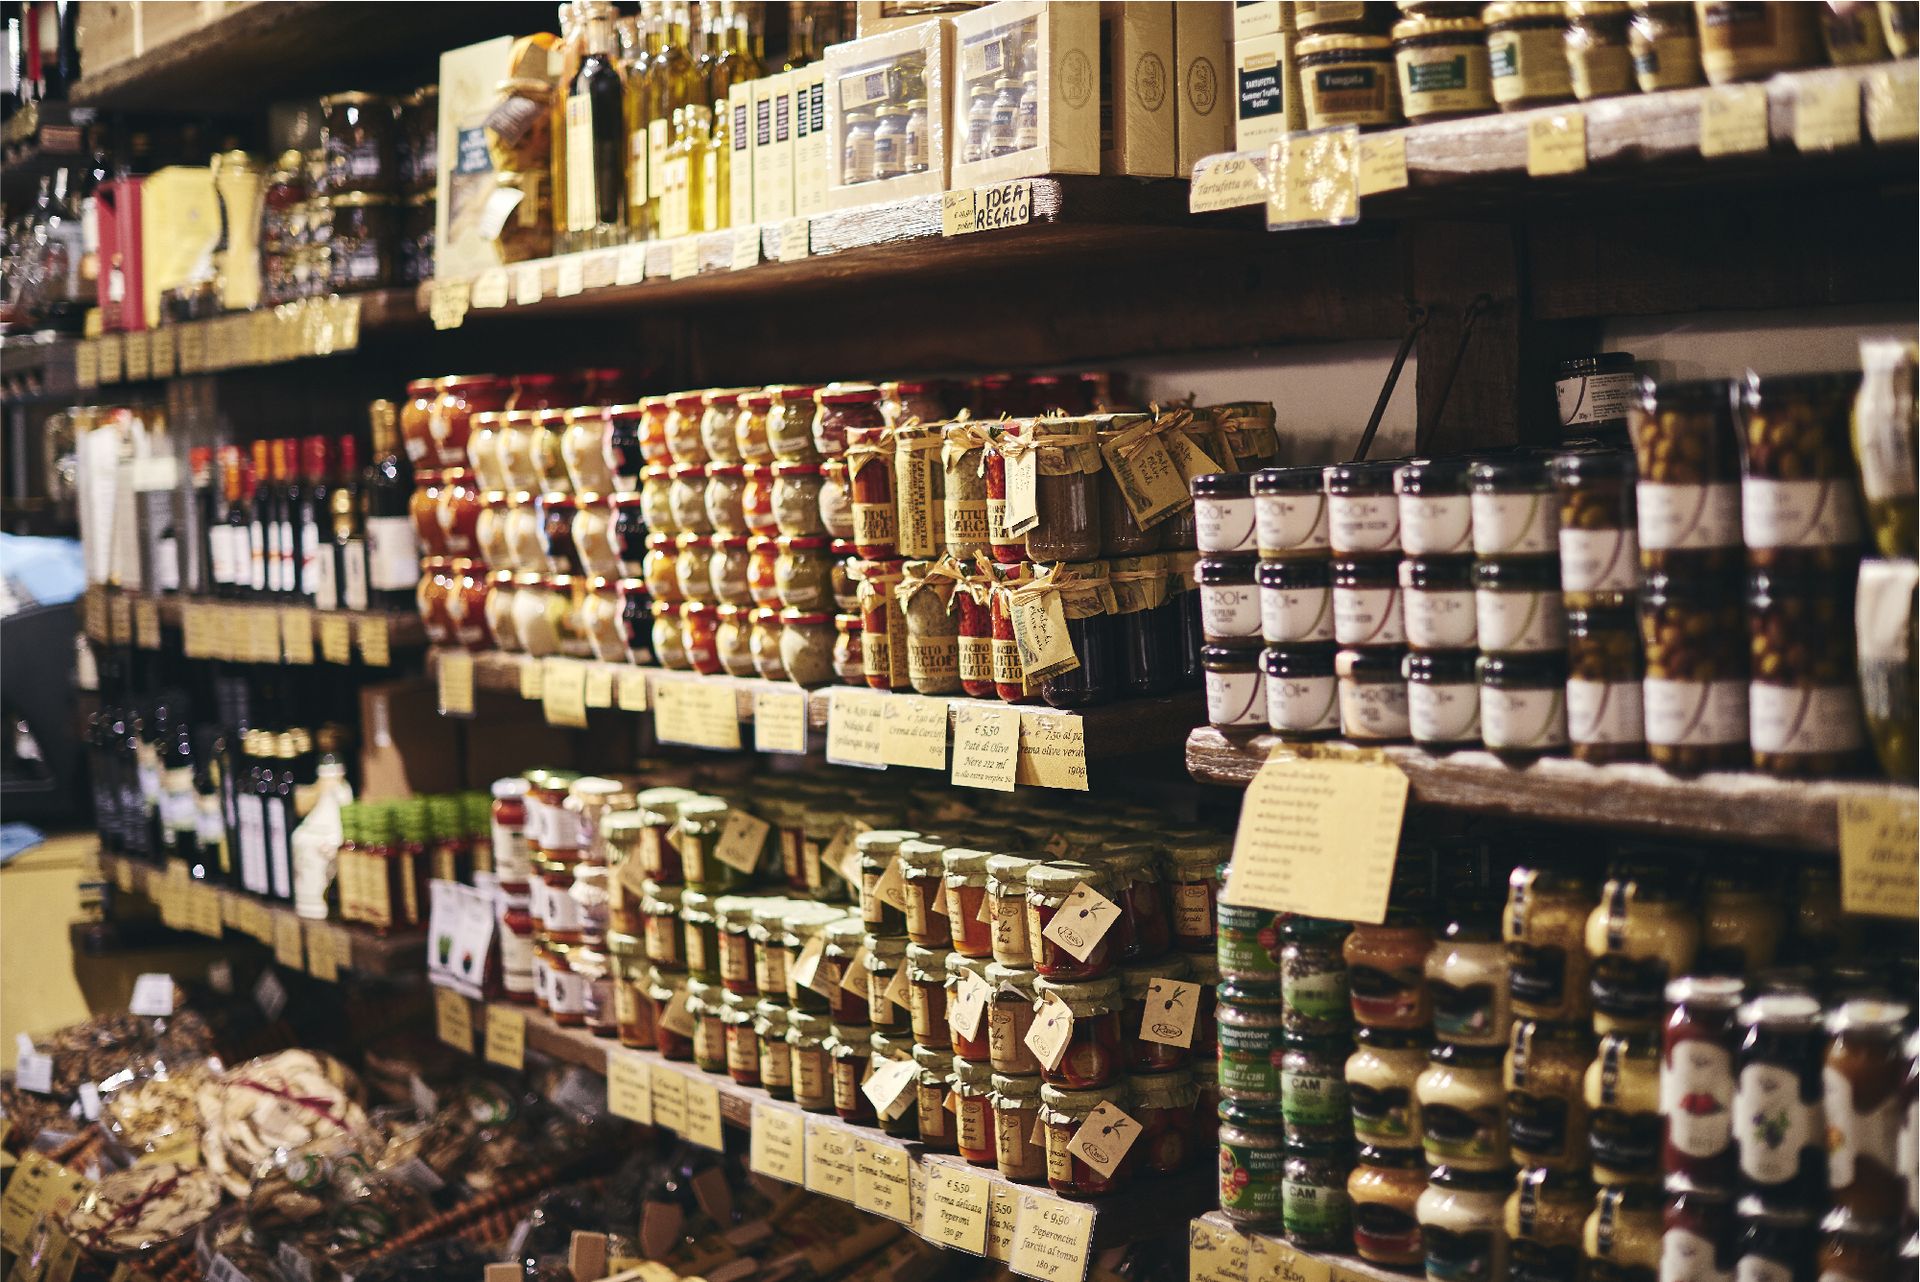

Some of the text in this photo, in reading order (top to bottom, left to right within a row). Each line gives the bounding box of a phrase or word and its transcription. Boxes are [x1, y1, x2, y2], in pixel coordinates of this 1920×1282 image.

[977, 204, 1028, 229] REGALO
[981, 741, 989, 752] di
[990, 742, 1010, 754] Olive
[1020, 746, 1041, 755] rema
[1041, 745, 1061, 757] olive
[964, 756, 982, 768] Nere
[953, 1181, 970, 1194] 5,50
[934, 1192, 982, 1215] Crema delicata
[994, 1202, 1012, 1215] 5,50
[940, 1209, 970, 1227] Peperoni
[1044, 1210, 1070, 1226] € 9,90
[1032, 1224, 1078, 1247] Peperoncini
[1020, 1237, 1047, 1254] farciti
[1047, 1245, 1056, 1257] al
[1036, 1259, 1060, 1275] 180 gr
